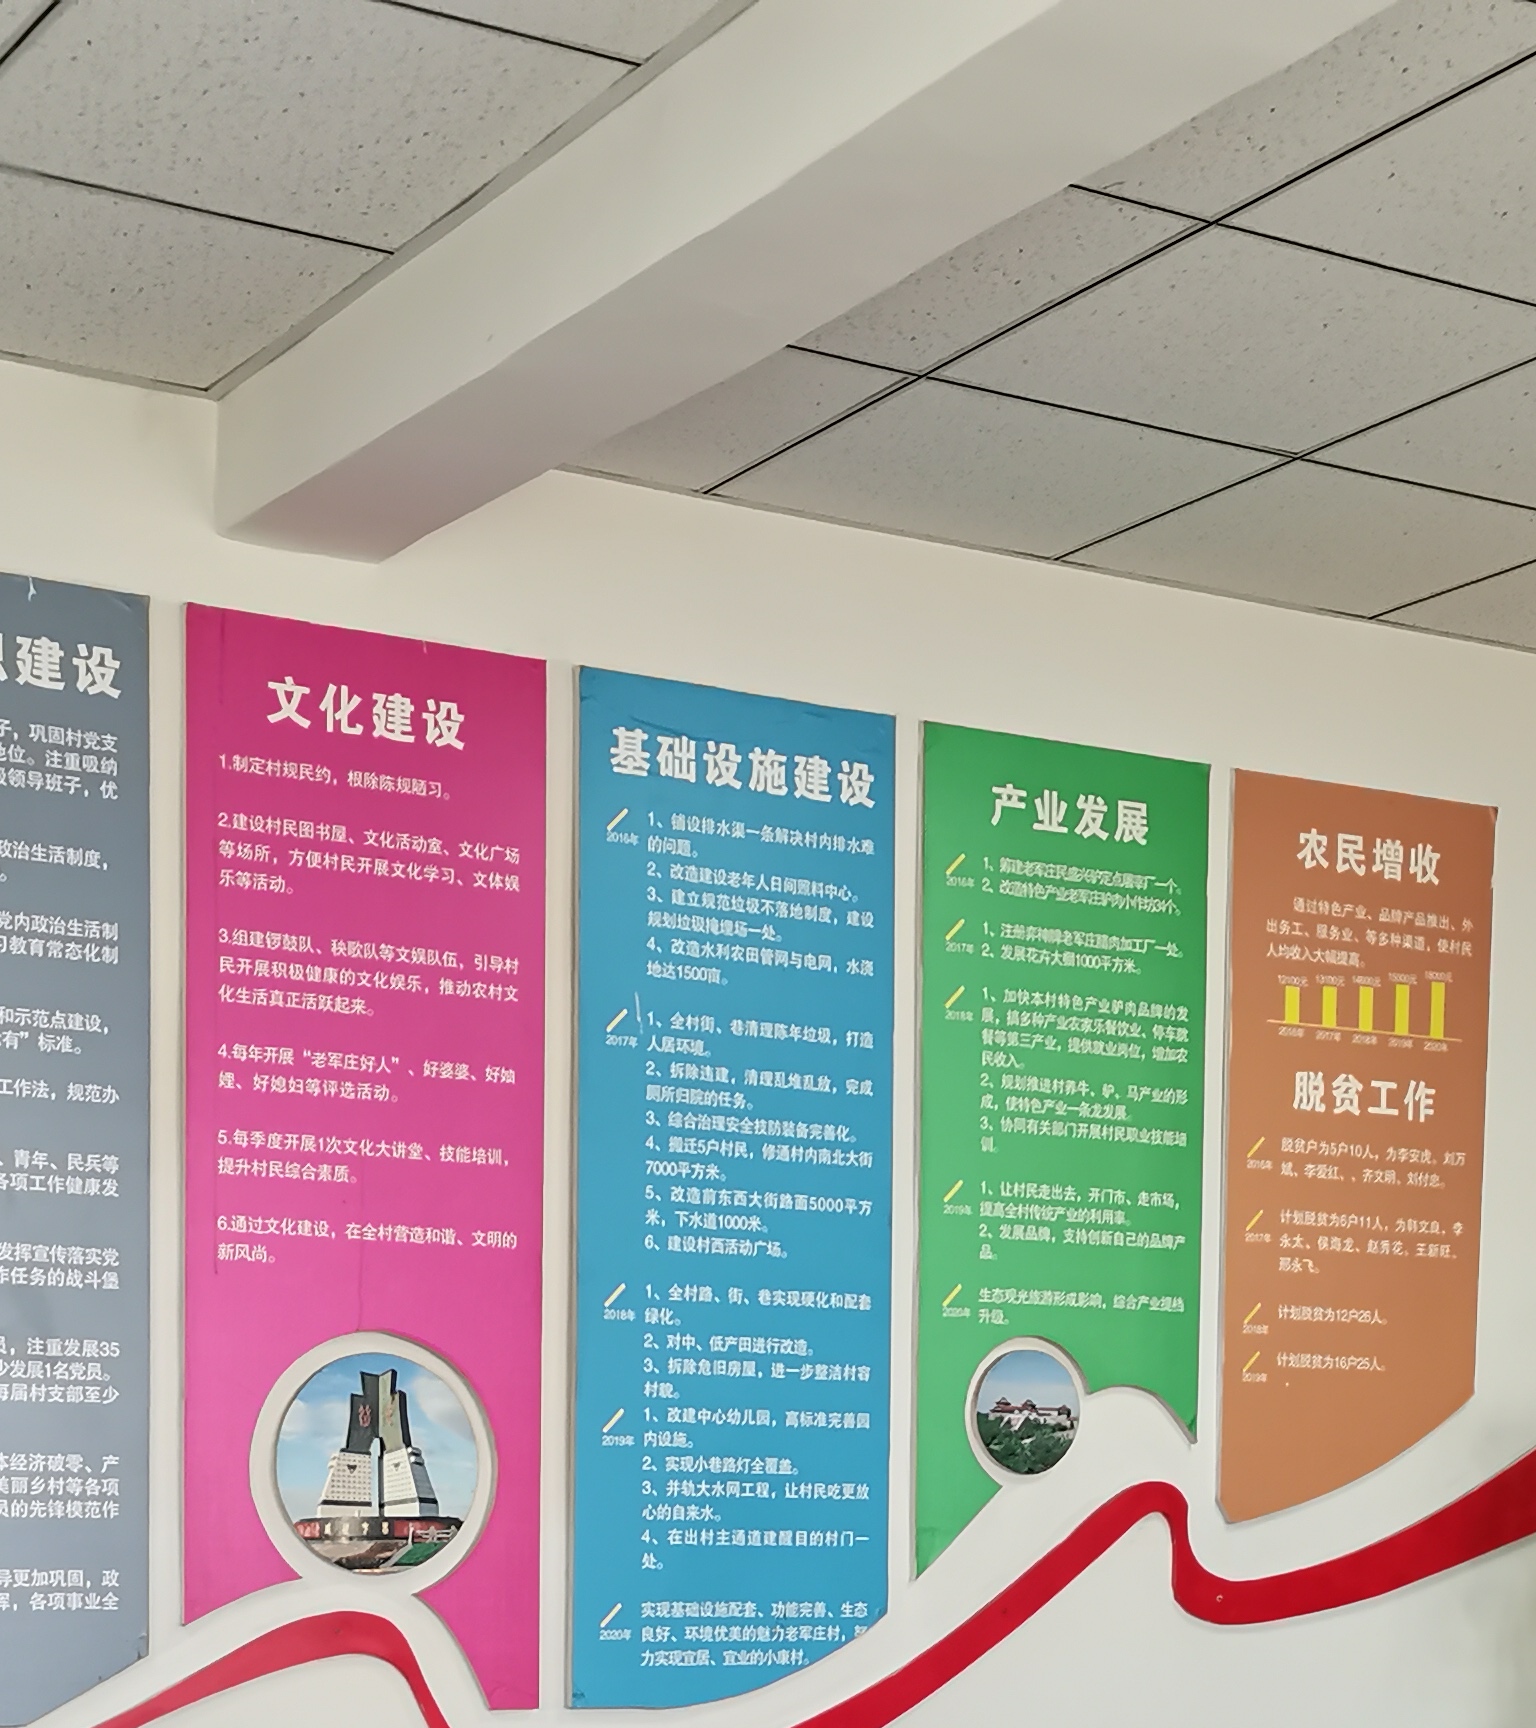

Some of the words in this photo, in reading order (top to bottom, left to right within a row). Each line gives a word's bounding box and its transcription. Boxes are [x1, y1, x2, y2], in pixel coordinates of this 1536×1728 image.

[266, 675, 465, 751] 文化建设
[609, 725, 876, 809] 基础设施建设
[990, 783, 1148, 846] 产业发展
[1296, 828, 1441, 886] 农民增收
[1292, 1070, 1437, 1123] 脱贫工作
